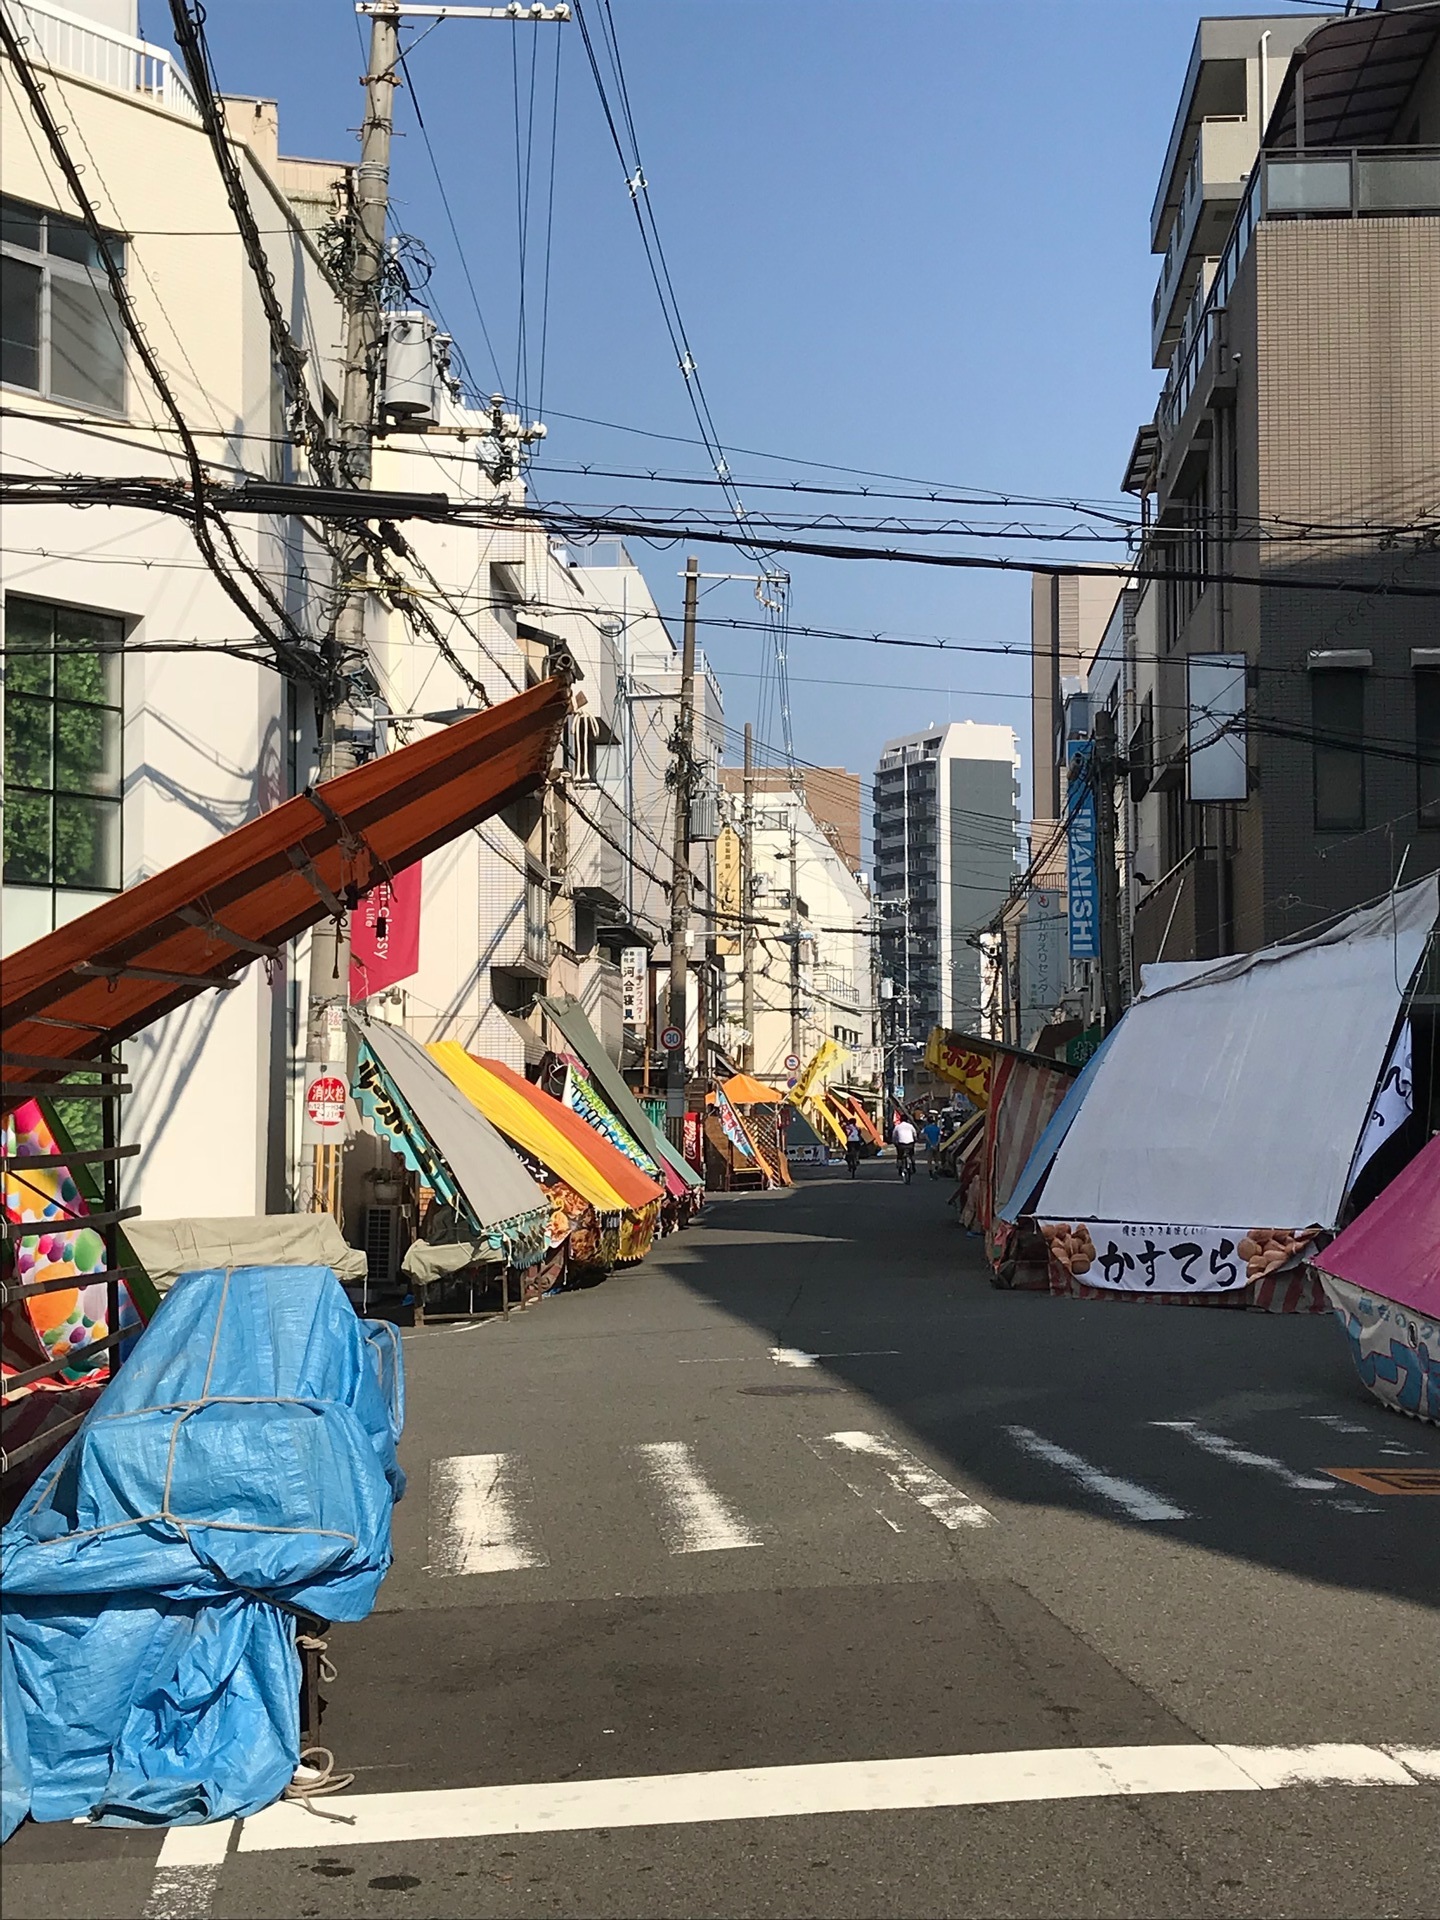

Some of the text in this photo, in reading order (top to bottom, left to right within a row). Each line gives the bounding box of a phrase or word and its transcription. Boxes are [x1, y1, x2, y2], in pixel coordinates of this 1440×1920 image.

[1071, 808, 1093, 951] IMANISHI
[1037, 911, 1049, 1004] わかがえりセンター
[623, 966, 635, 1021] 河合寝具
[665, 1033, 679, 1044] 30
[311, 1084, 344, 1102] 消火栓
[1098, 1238, 1238, 1288] かすてら
